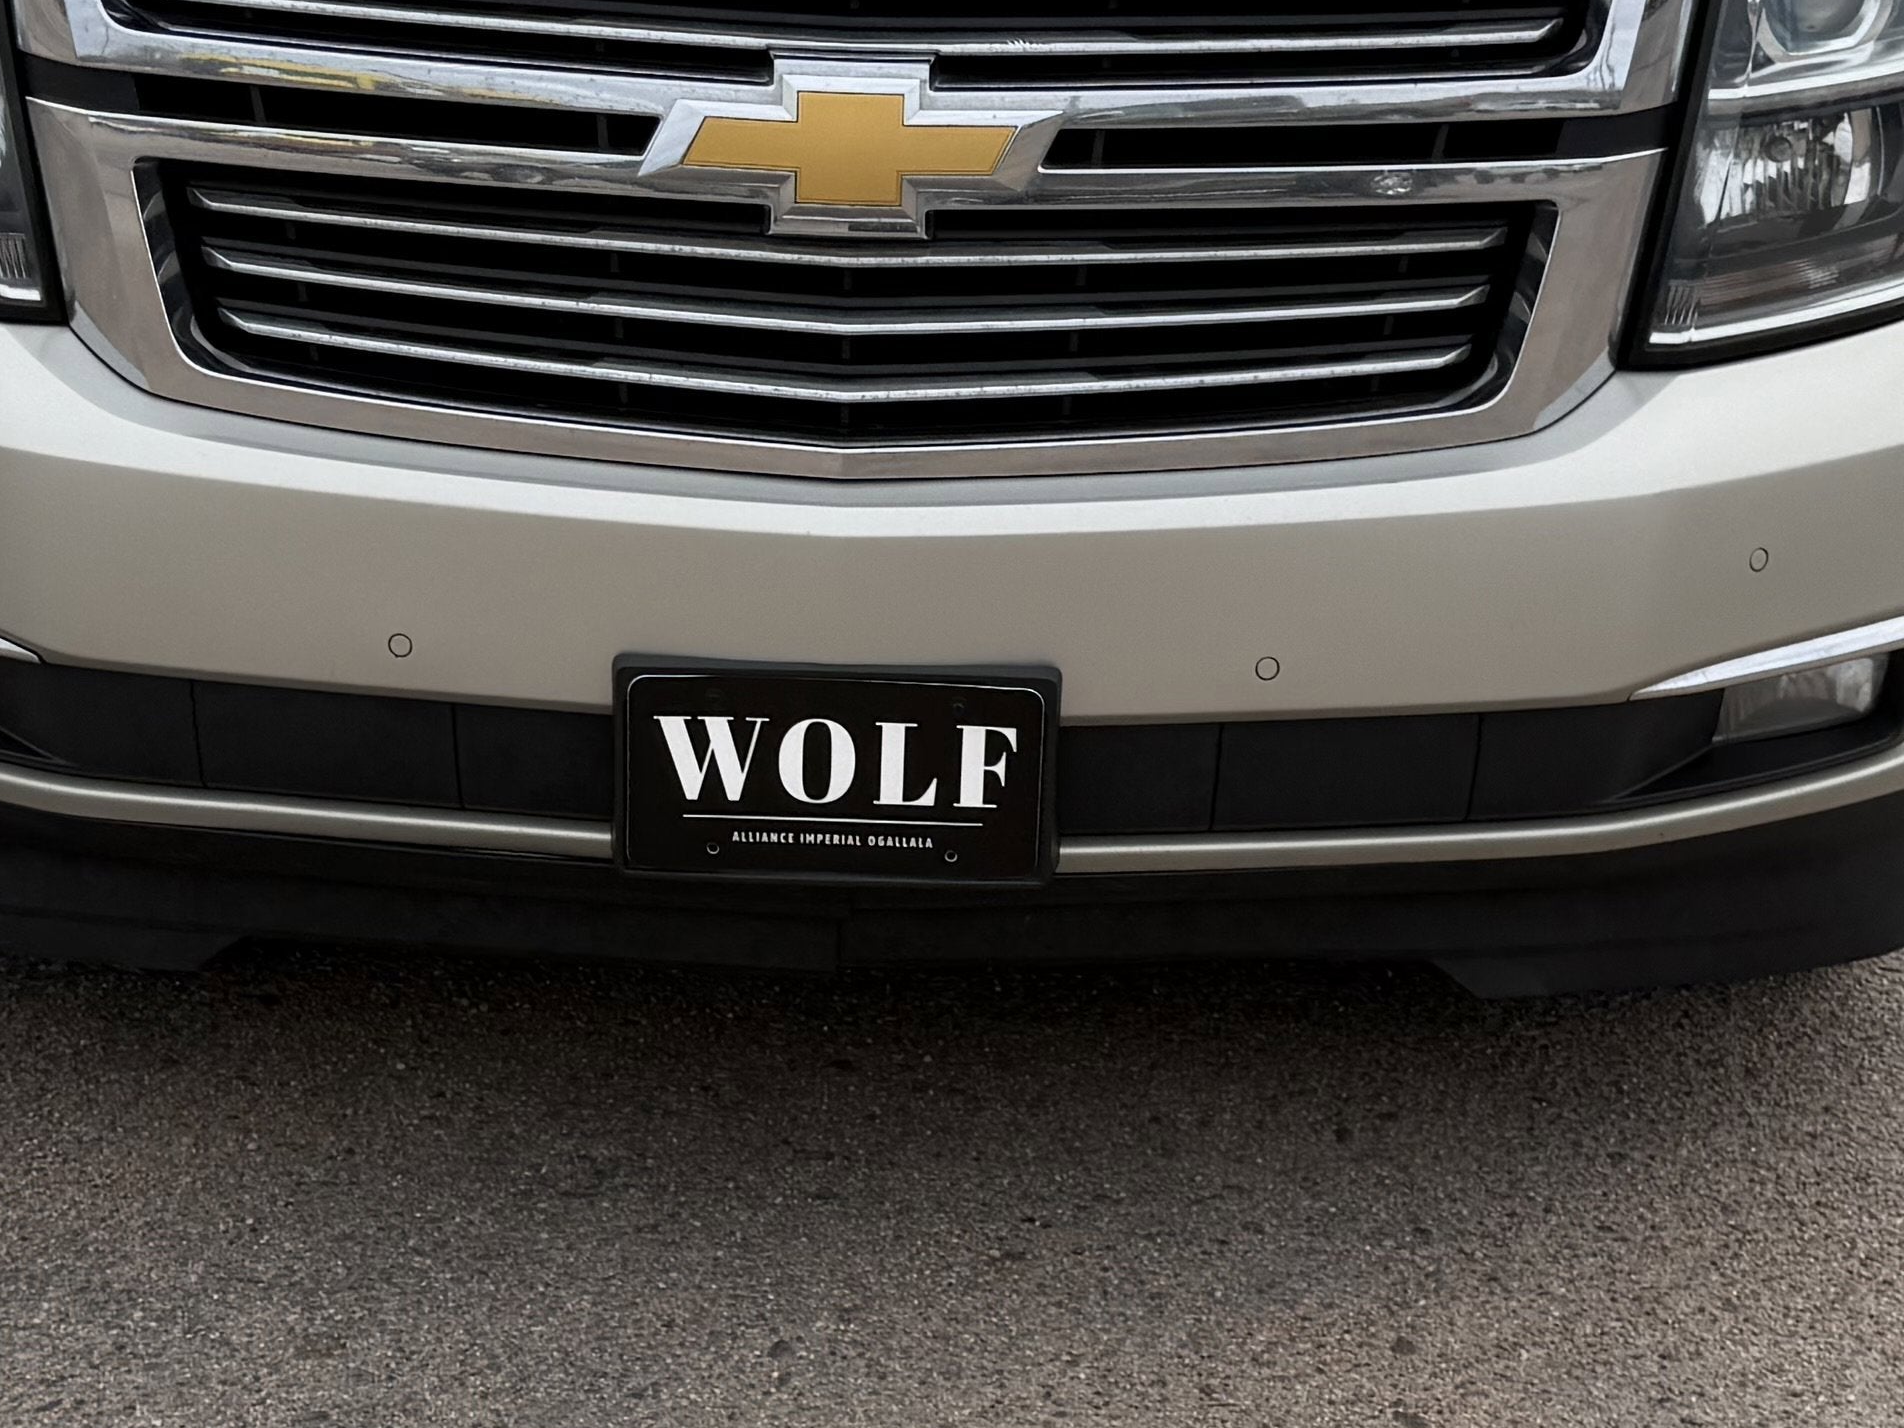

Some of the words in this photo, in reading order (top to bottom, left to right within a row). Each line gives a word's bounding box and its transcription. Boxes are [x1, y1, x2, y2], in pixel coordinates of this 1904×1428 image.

[652, 715, 1018, 809] WOLF
[732, 831, 795, 844] ALLIANCE
[799, 833, 862, 846] IMPERIAL
[867, 835, 934, 849] OGALLALA
